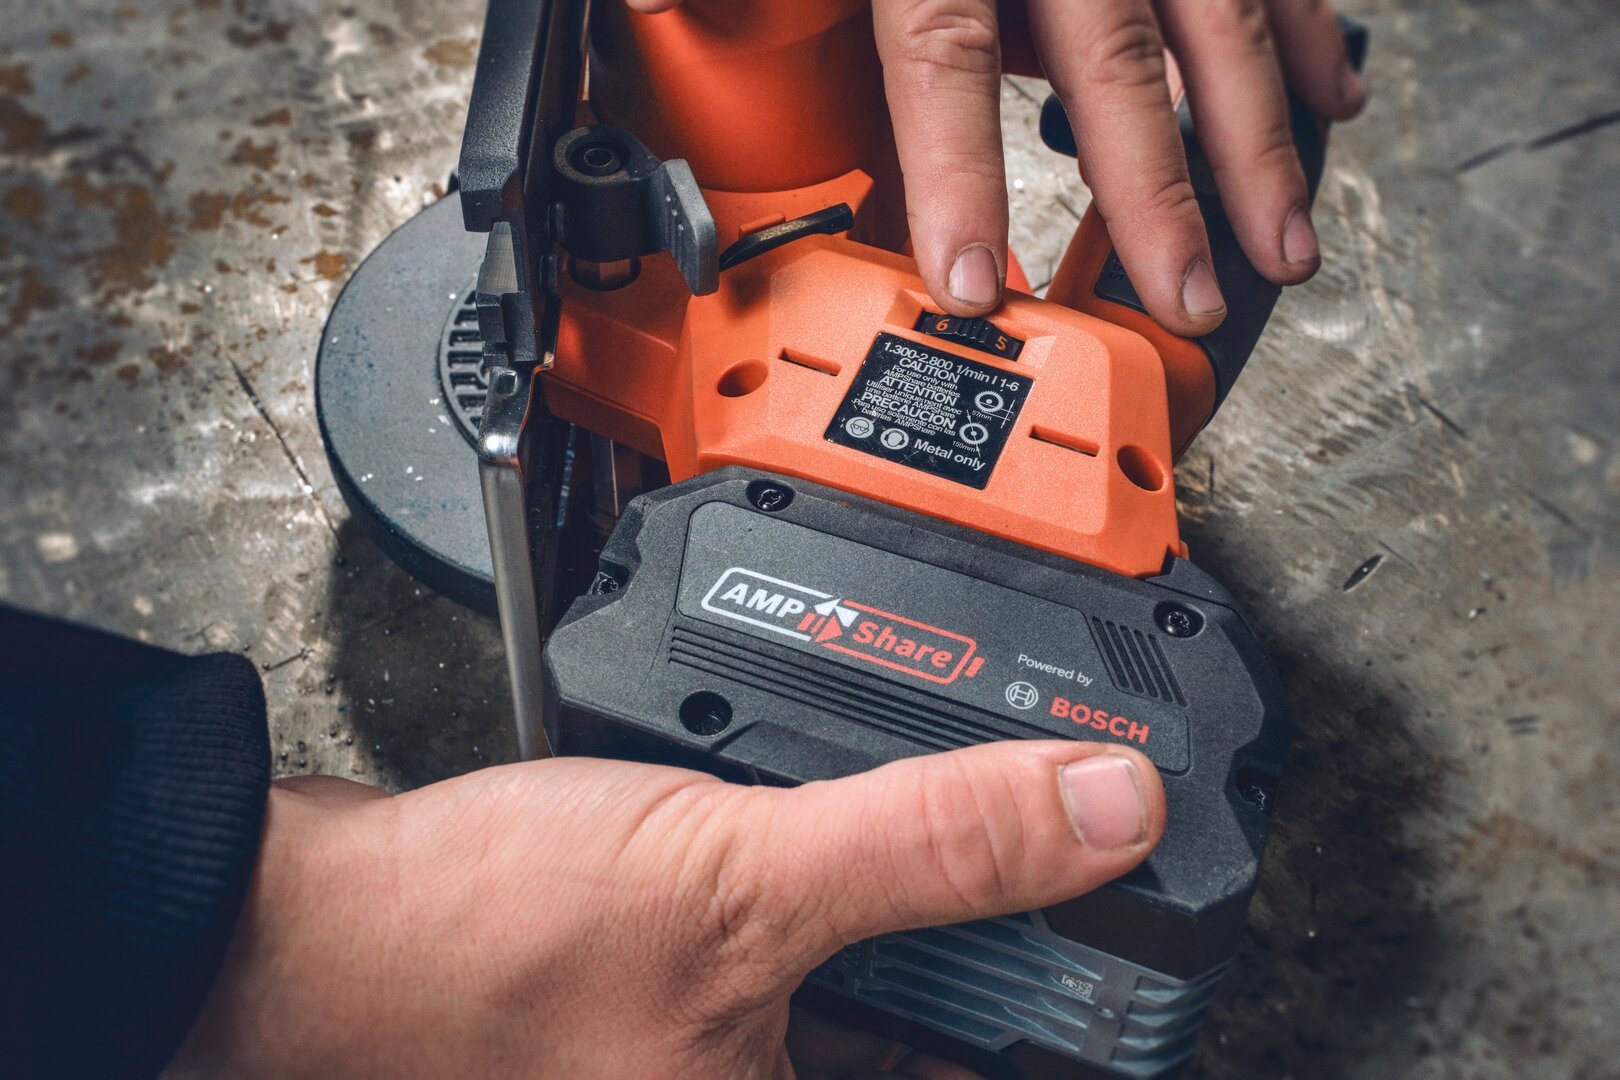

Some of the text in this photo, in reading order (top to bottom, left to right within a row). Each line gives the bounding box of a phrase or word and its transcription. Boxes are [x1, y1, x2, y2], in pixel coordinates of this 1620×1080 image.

[935, 318, 950, 332] 6
[994, 335, 1008, 351] 5
[883, 369, 960, 399] AMPShare batteries
[892, 365, 958, 391] For use only with
[899, 357, 961, 384] CAUTION
[956, 364, 990, 383] 1/min
[1000, 378, 1020, 392] 1-6
[866, 380, 894, 394] Utiliser
[879, 376, 957, 407] ATTENTION
[853, 398, 956, 437] Para uso solamente con las
[861, 392, 957, 430] PRECAUCION
[865, 386, 881, 396] une
[912, 402, 955, 419] AMPShare
[894, 418, 936, 436] AMPShare
[914, 438, 986, 472] Metal only
[719, 582, 953, 669] AMP Share
[1017, 654, 1093, 687] Powered by
[1049, 696, 1151, 745] BOSCH
